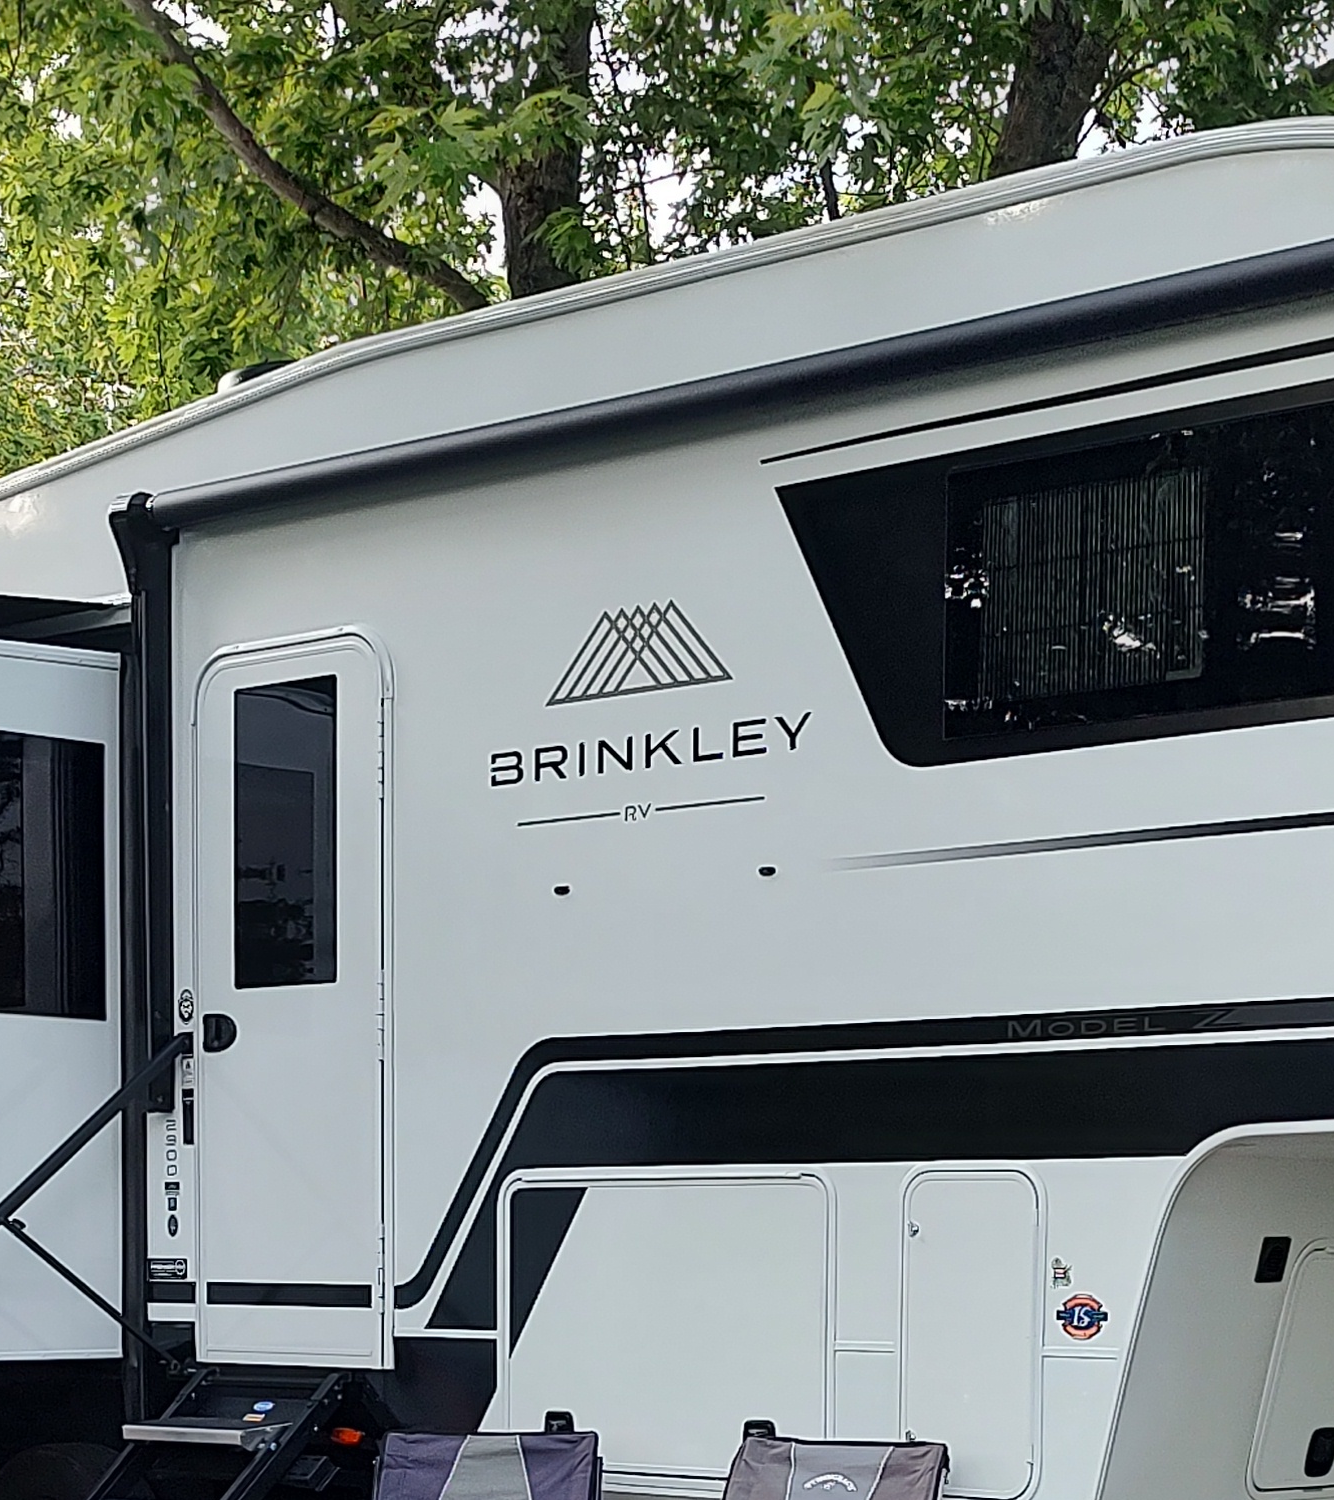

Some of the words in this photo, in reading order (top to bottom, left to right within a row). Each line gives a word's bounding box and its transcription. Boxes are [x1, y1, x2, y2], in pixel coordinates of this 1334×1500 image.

[490, 711, 812, 787] BRINKLEY
[624, 803, 652, 821] RV
[1007, 1016, 1166, 1039] MODEL
